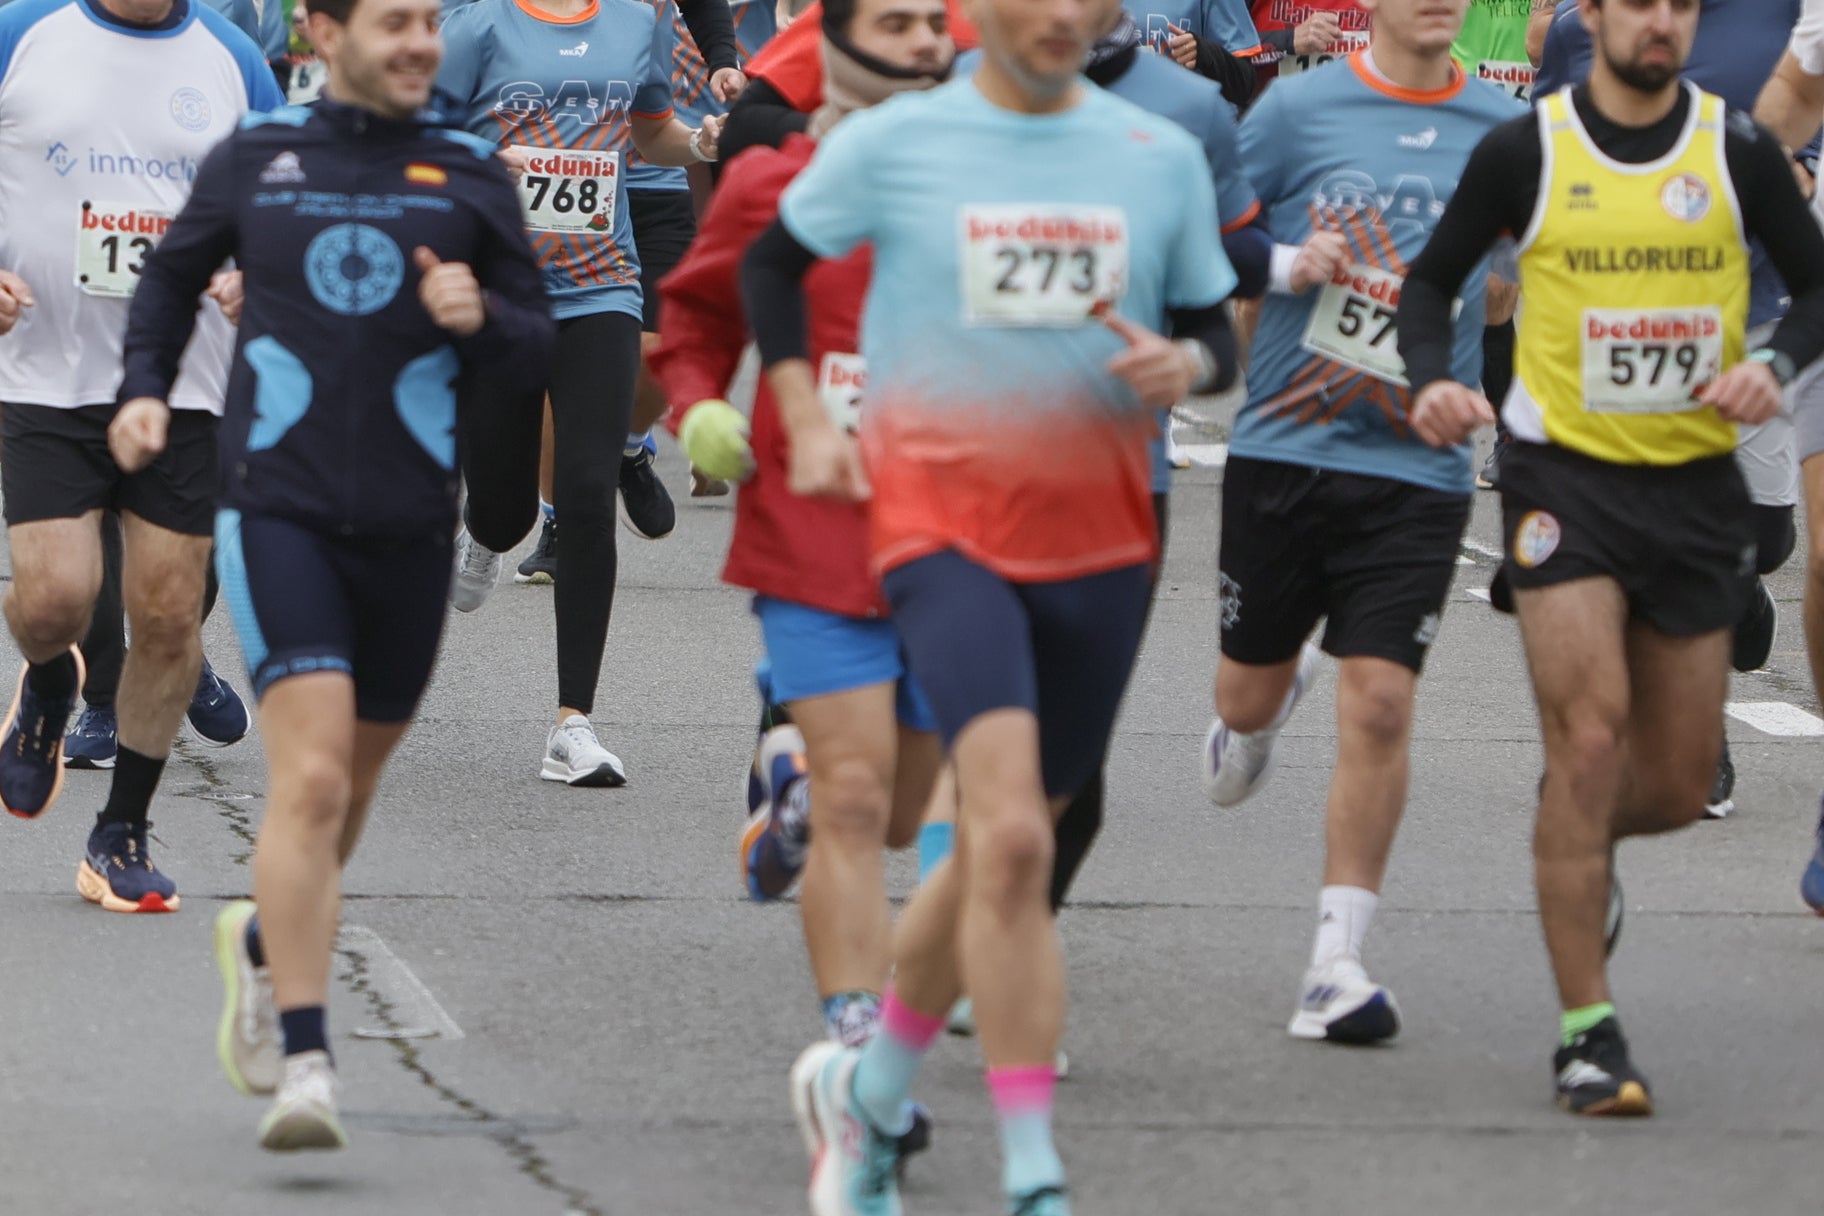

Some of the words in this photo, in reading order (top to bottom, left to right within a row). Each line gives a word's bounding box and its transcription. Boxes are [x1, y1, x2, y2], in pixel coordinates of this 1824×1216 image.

[88, 147, 199, 182] inmocli
[526, 175, 599, 214] 768
[967, 217, 1121, 246] bedunia
[995, 247, 1098, 295] 273
[1587, 315, 1718, 340] bedunia
[1610, 344, 1700, 388] 579
